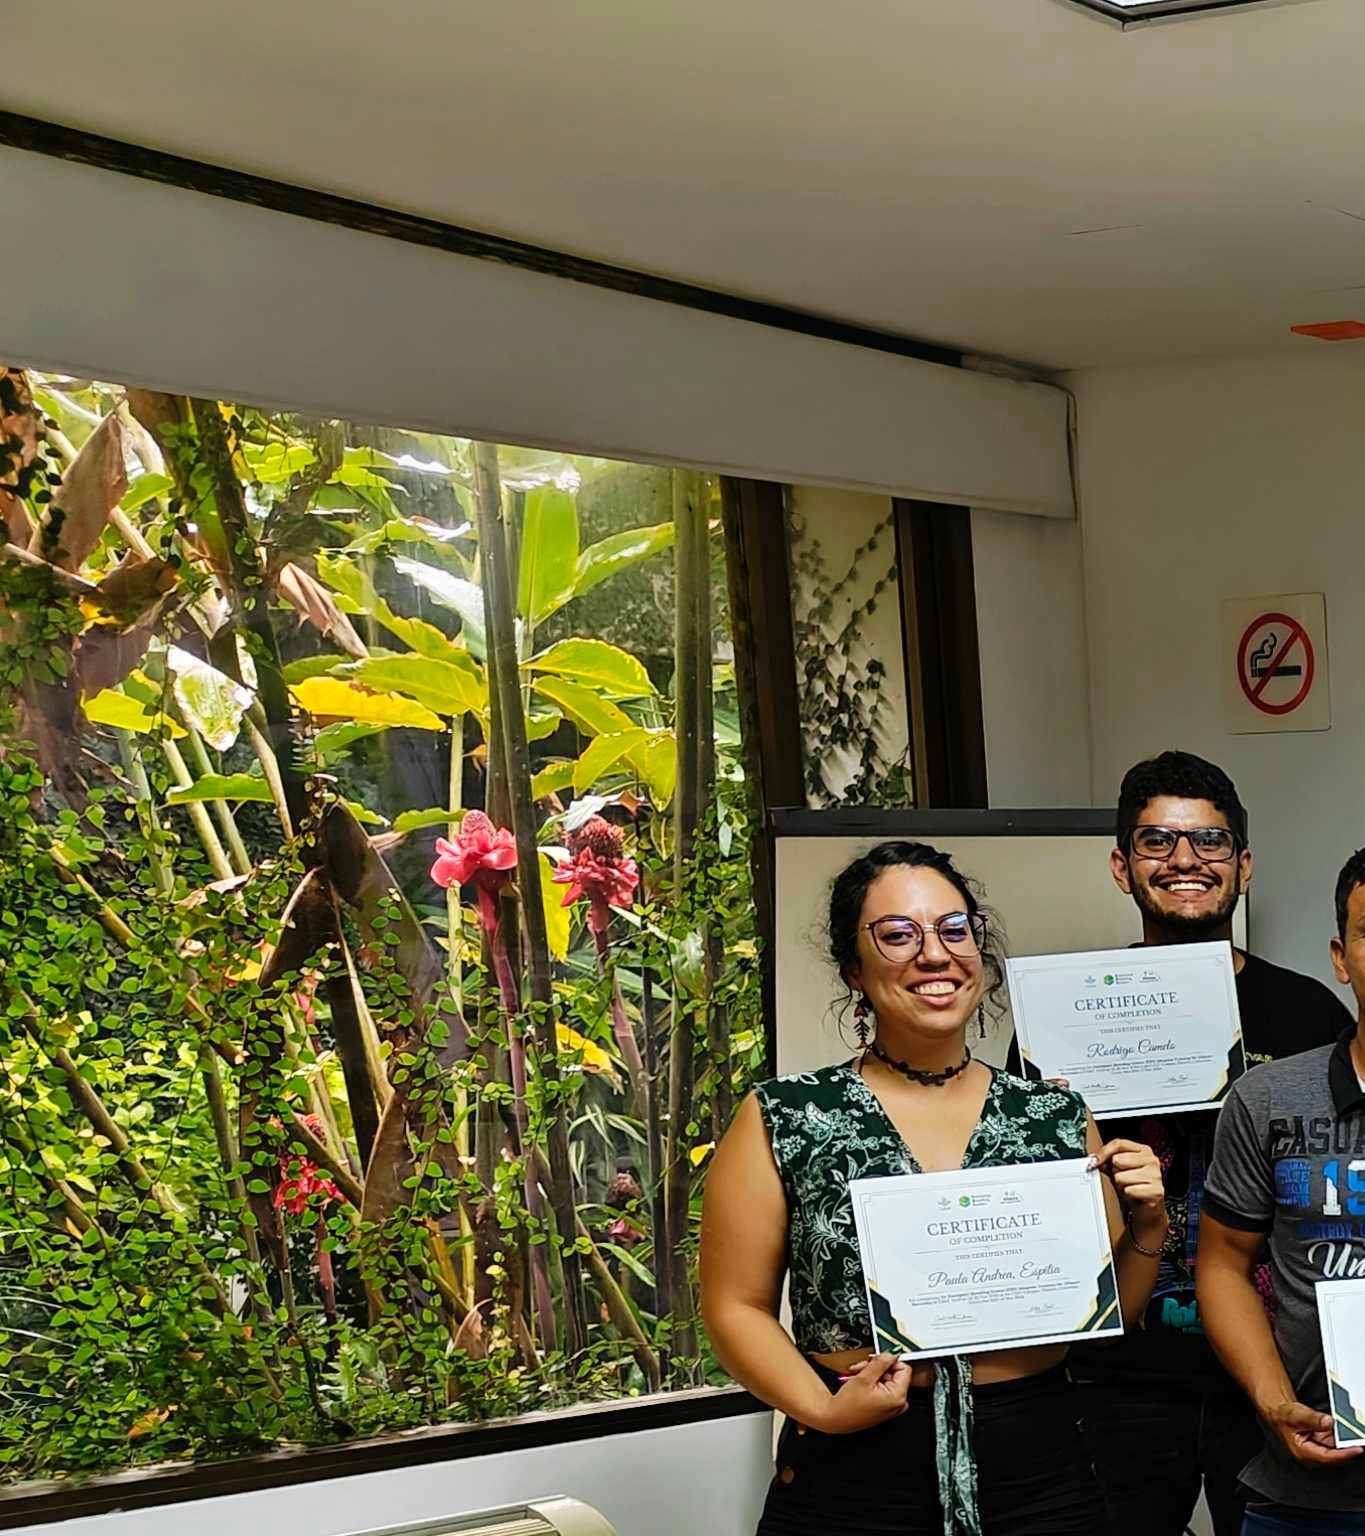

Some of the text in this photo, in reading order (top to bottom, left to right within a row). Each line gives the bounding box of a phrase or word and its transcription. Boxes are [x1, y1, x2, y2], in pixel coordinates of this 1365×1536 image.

[1075, 992, 1178, 1011] CERTIFICATE
[1108, 1008, 1161, 1019] COMPLETION
[928, 1213, 1041, 1236] CERTIFICATE
[964, 1232, 1023, 1243] COMPLETION
[928, 1271, 968, 1288] Paula
